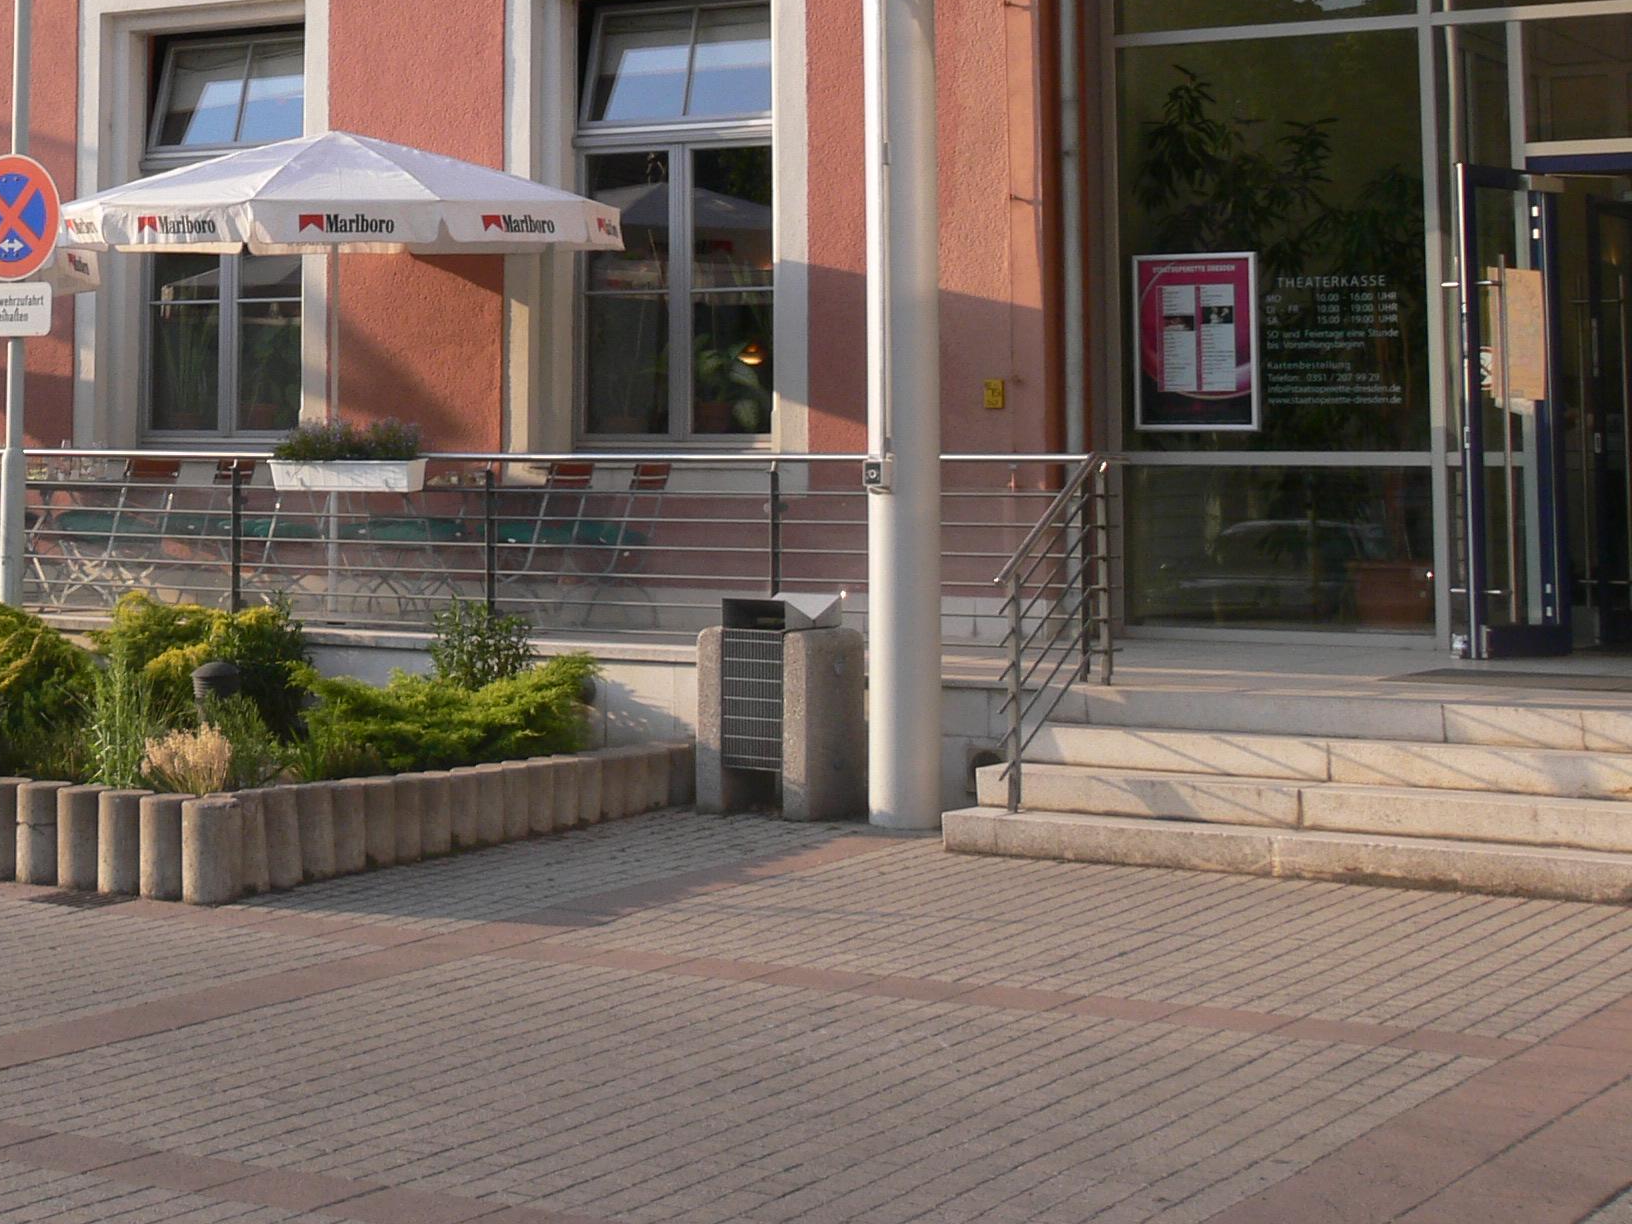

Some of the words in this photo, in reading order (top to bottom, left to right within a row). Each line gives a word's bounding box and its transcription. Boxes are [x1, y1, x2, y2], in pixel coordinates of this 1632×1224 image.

[158, 215, 216, 235] Marlboro
[325, 213, 395, 234] Marlboro
[502, 214, 556, 235] Marlboro
[1277, 275, 1387, 288] THEATERKASSE
[1265, 294, 1282, 303] MO
[1377, 291, 1397, 301] UHR
[1377, 303, 1398, 312] UHR
[1378, 314, 1399, 323] UHR
[1282, 329, 1300, 338] und
[1304, 329, 1344, 340] Feiertage
[1346, 330, 1366, 338] eine
[1367, 328, 1400, 337] Stunde
[1267, 360, 1352, 371] Kartenbestellung
[1268, 395, 1402, 406] www.staatsoperette-dresden.de
